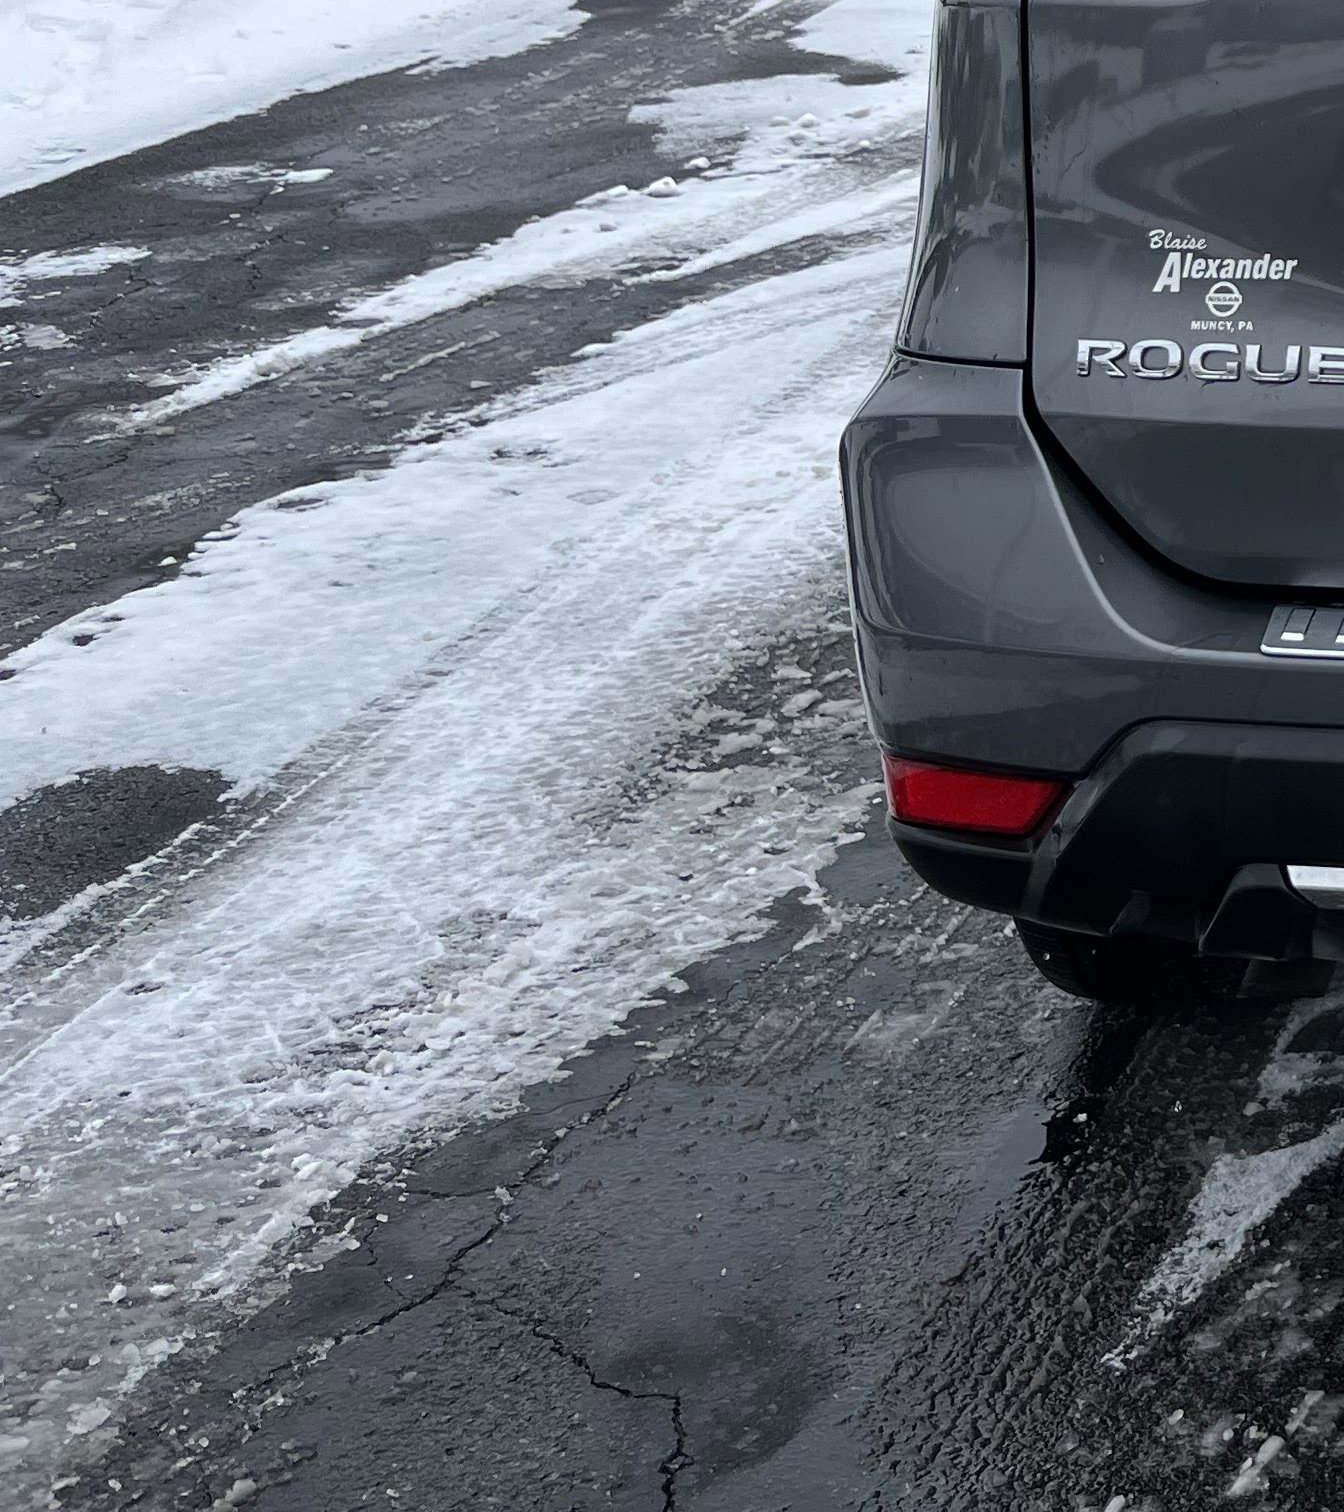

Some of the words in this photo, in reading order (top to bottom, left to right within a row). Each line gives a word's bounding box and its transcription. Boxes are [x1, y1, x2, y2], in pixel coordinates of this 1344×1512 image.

[1148, 228, 1208, 250] Blaise
[1152, 251, 1299, 293] Alexander
[1190, 320, 1235, 334] MUNCY,
[1237, 320, 1254, 331] PA
